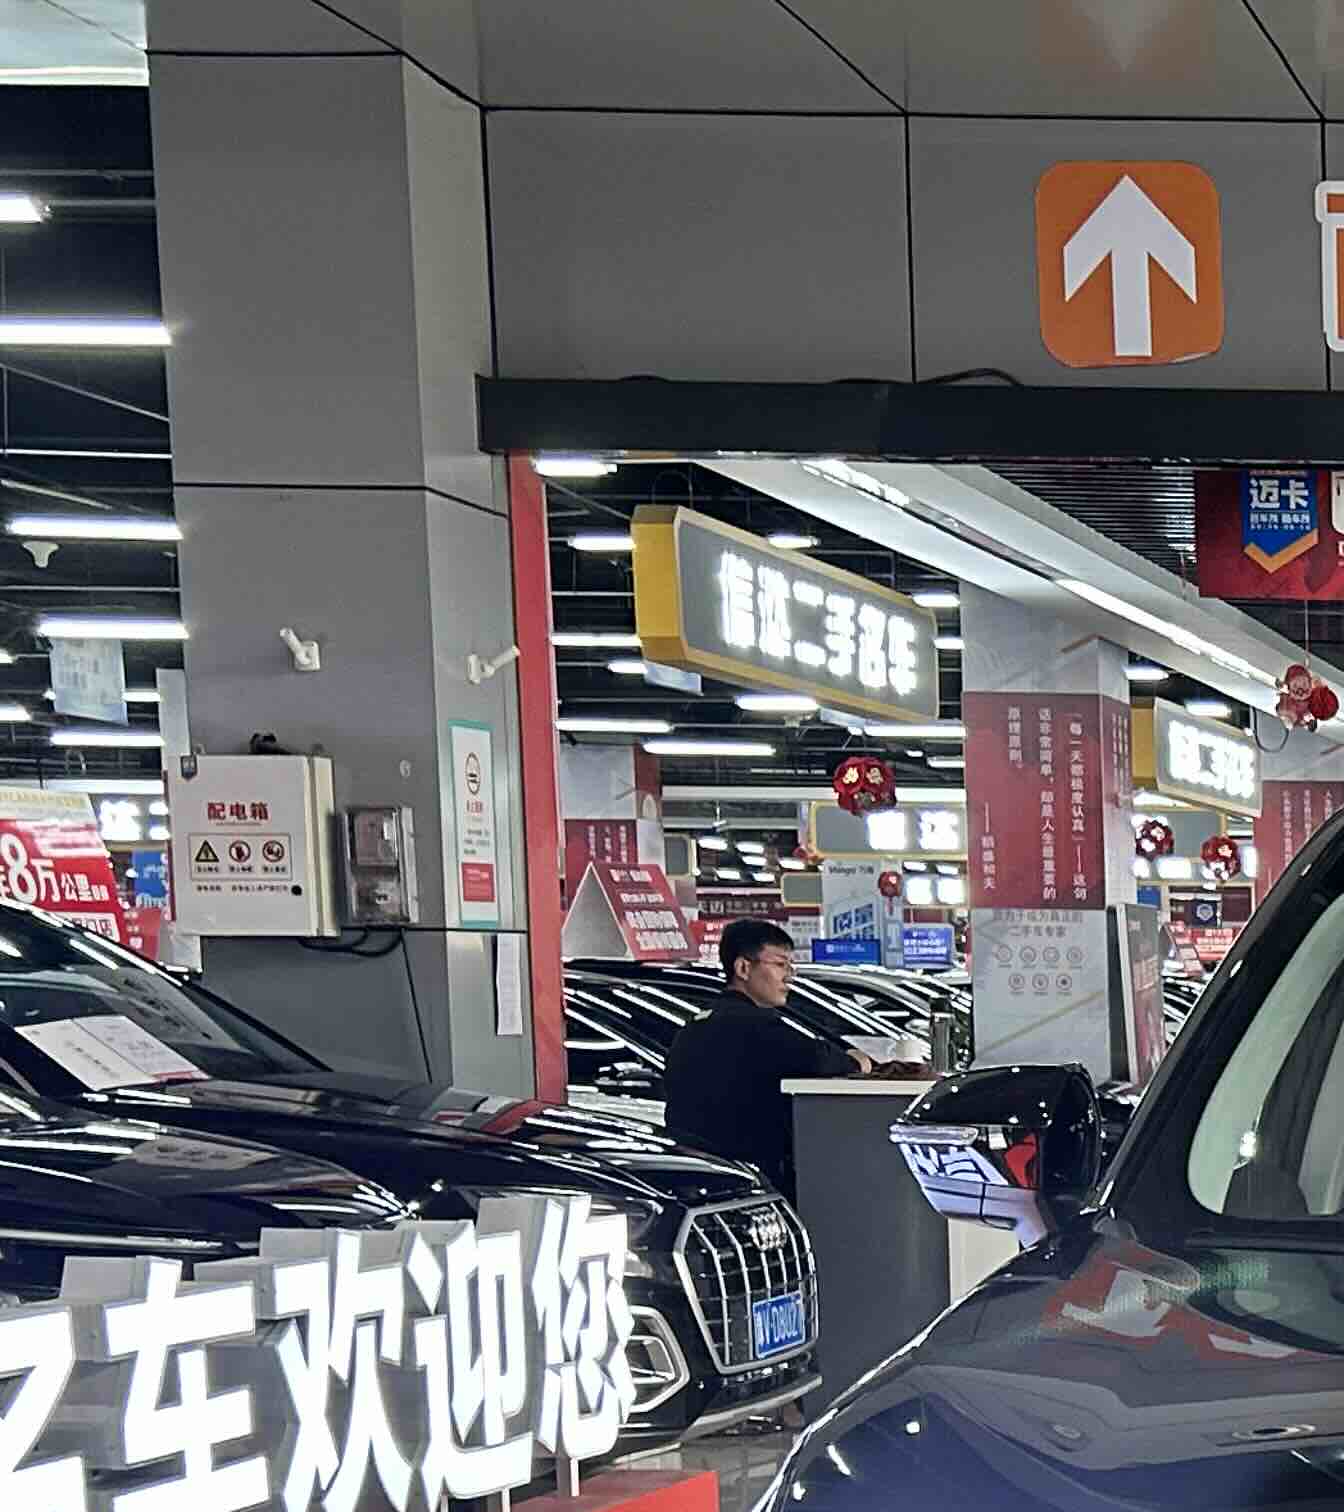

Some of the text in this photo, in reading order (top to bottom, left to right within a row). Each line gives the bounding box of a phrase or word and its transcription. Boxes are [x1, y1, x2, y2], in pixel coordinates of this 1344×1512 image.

[1250, 478, 1309, 510] 迈卡
[207, 802, 269, 821] 配电箱
